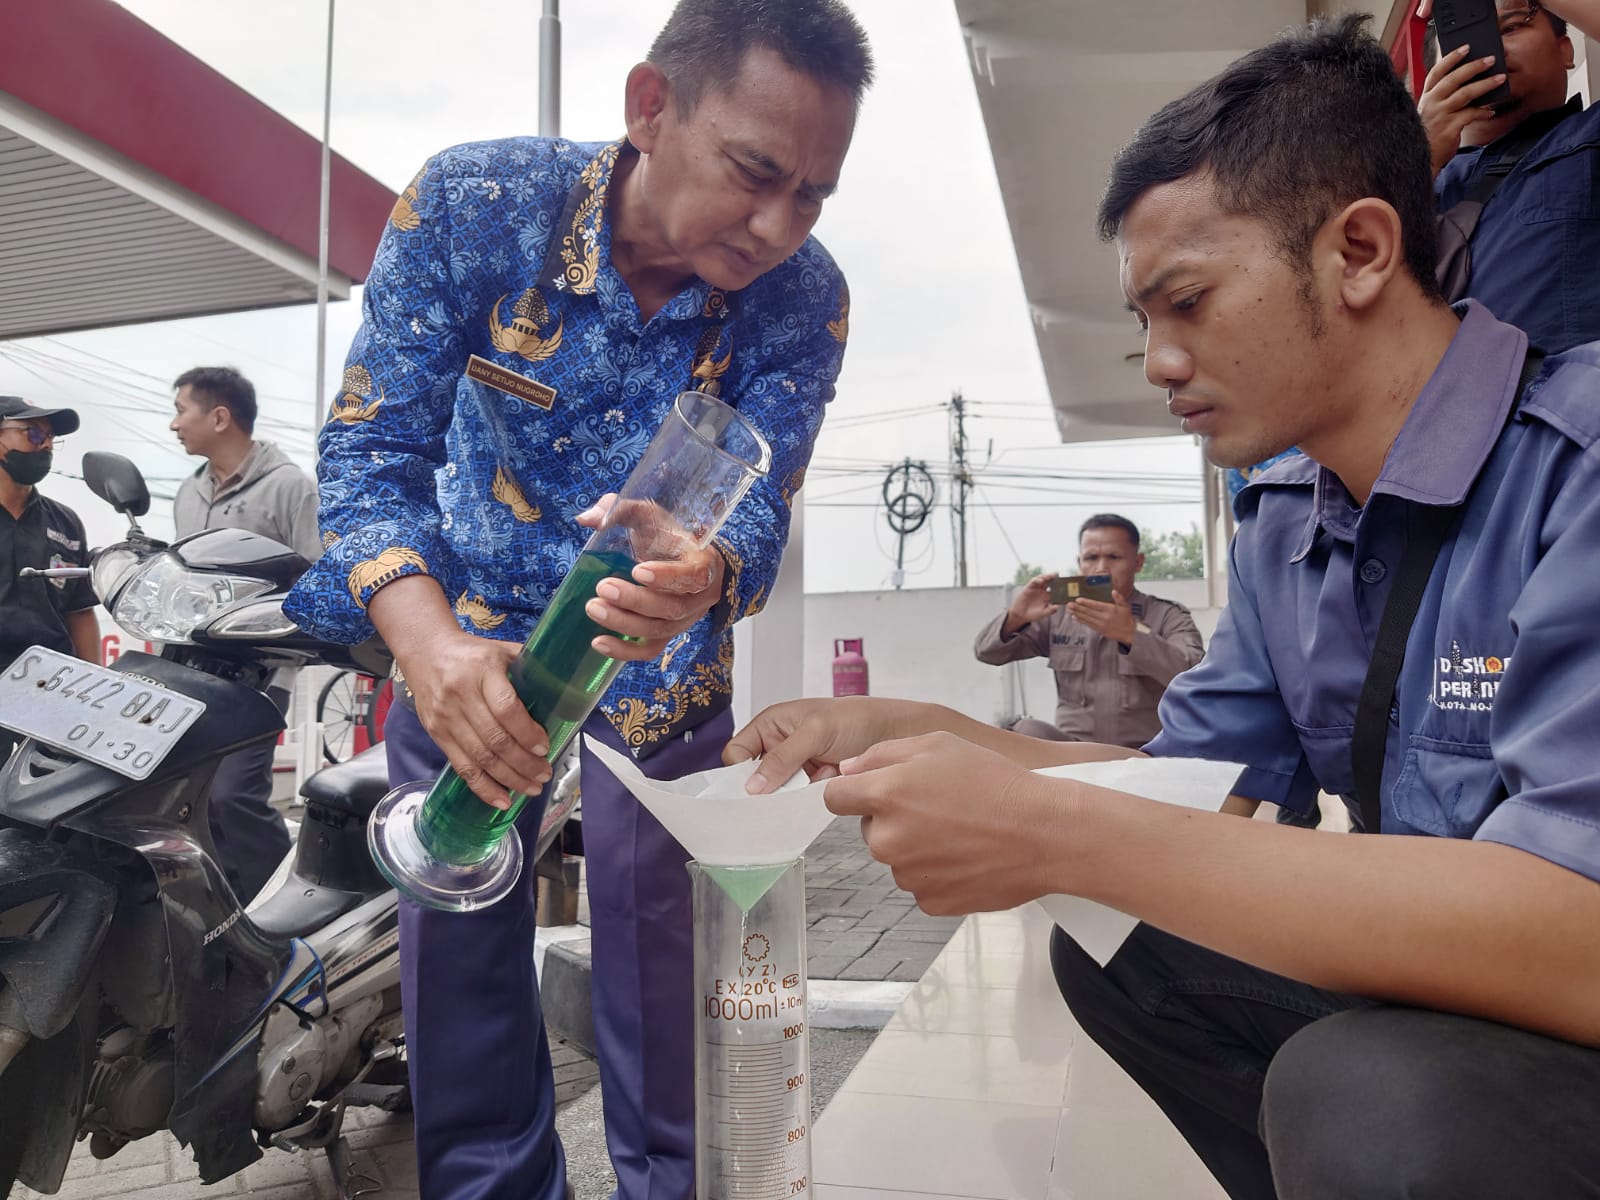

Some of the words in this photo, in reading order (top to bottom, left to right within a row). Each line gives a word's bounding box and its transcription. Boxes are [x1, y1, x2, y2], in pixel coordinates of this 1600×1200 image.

[516, 383, 550, 401] NUGROHO
[44, 665, 125, 709] 6442
[202, 908, 241, 946] HONDA
[704, 994, 778, 1021] 1000ml
[783, 1022, 804, 1040] 1000
[786, 1073, 805, 1090] 900
[787, 1126, 806, 1143] 800
[789, 1176, 807, 1194] 700
